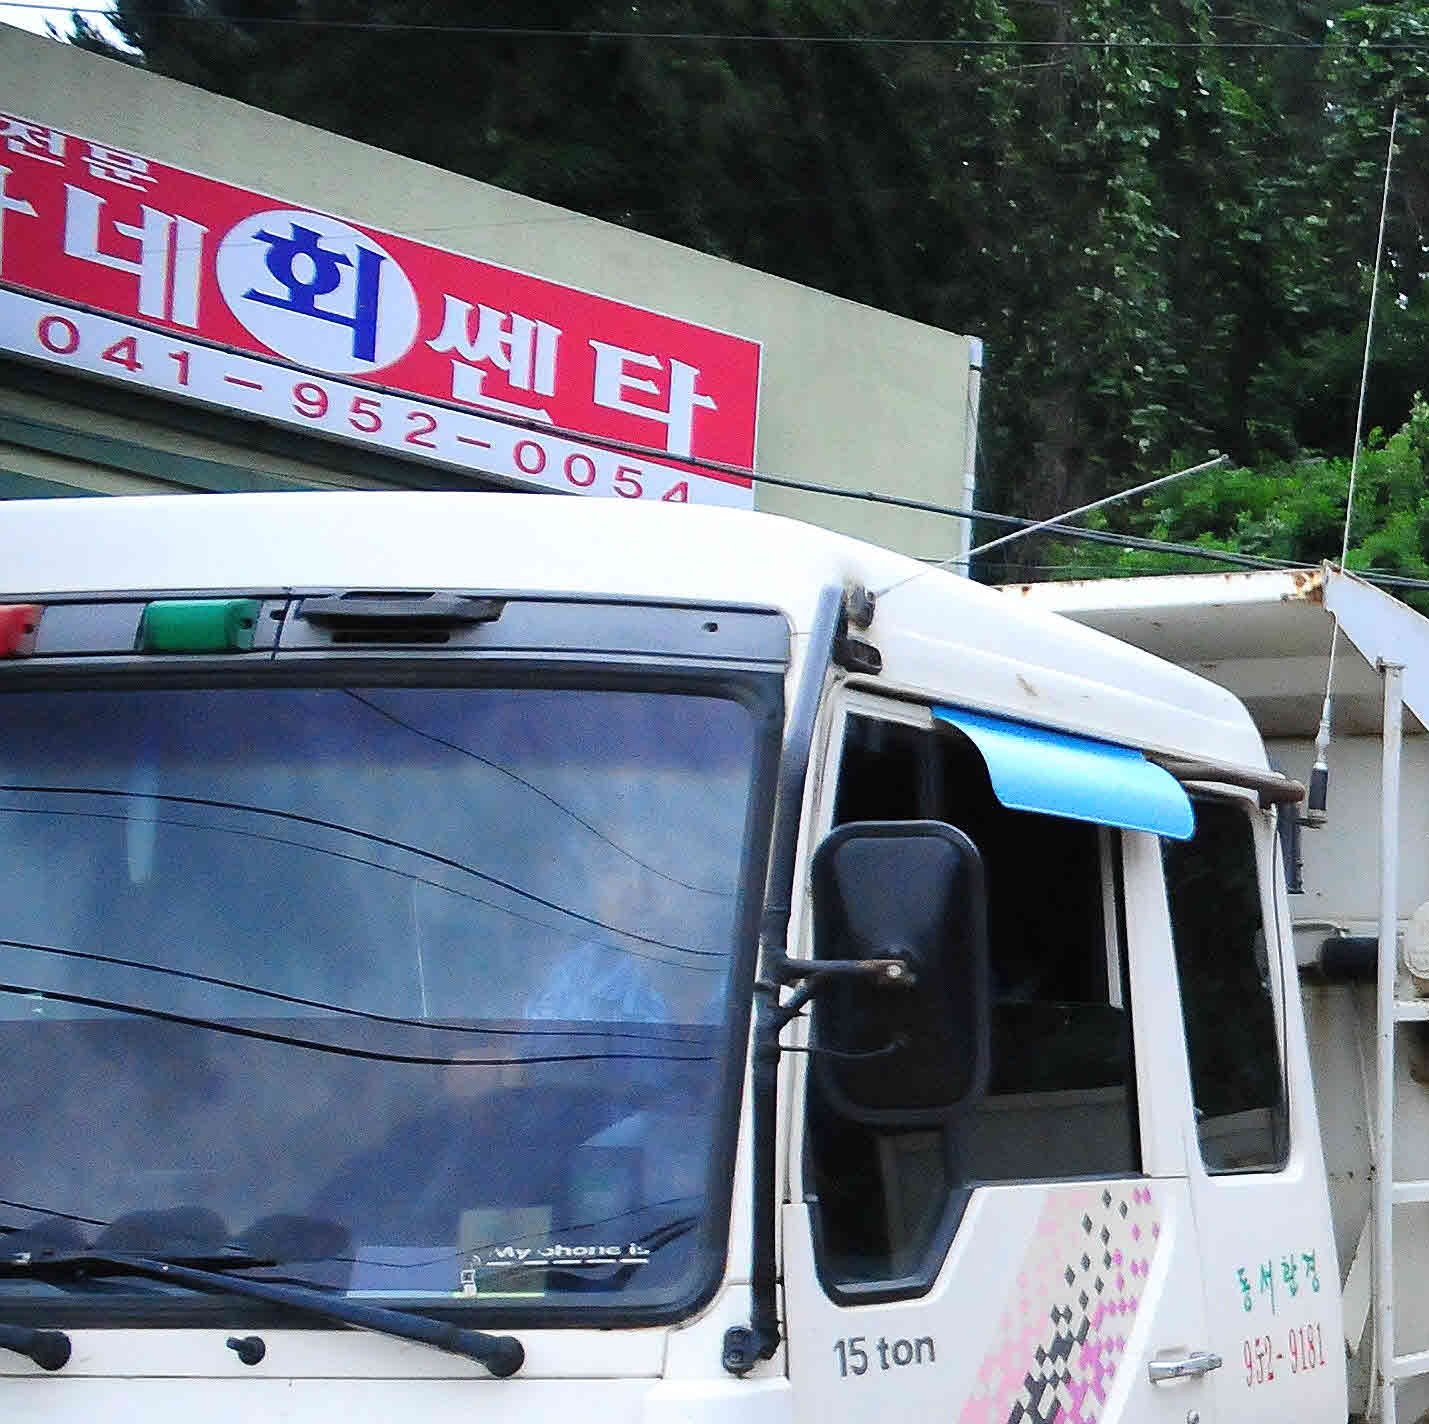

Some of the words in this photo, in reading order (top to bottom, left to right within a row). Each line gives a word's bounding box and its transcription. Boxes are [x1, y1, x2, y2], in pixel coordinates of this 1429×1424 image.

[240, 222, 388, 363] 회
[37, 315, 690, 503] 041-952-0054
[832, 1336, 868, 1377] 15
[876, 1336, 936, 1370] ton
